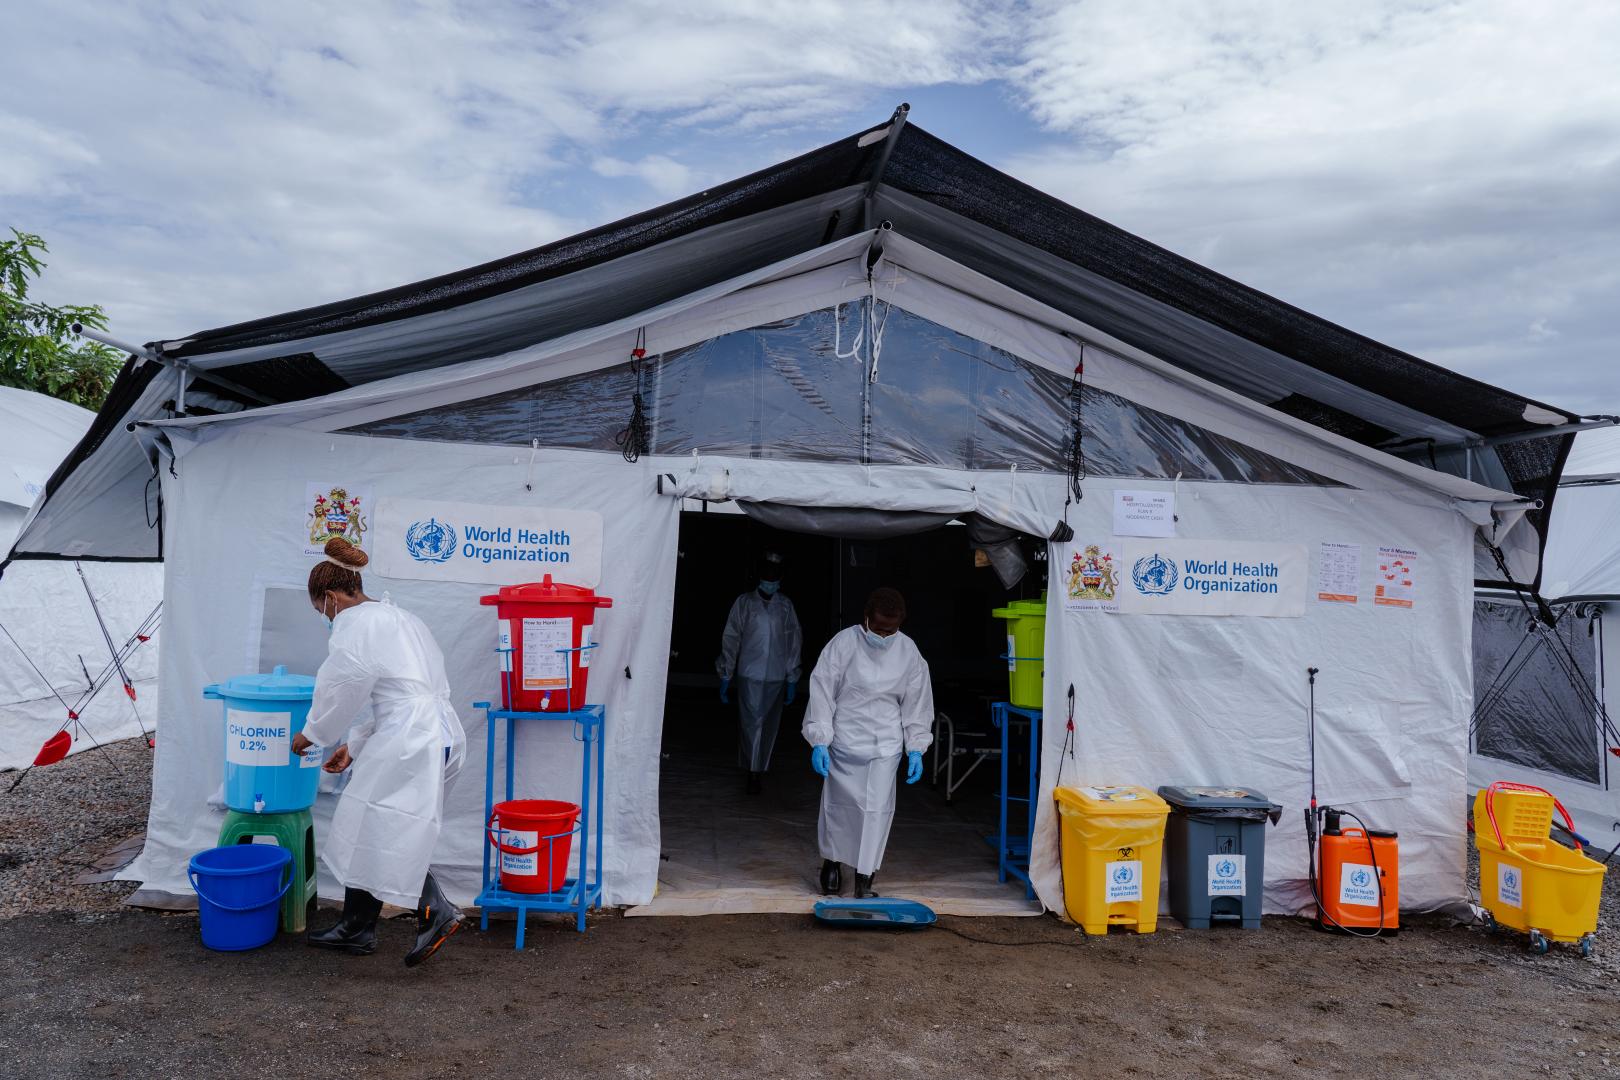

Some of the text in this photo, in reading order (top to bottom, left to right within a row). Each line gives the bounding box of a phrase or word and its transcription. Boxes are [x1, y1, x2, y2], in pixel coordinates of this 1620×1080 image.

[464, 525, 570, 546] World Health
[463, 543, 570, 564] Organization
[1184, 559, 1278, 578] World Health
[1184, 576, 1278, 594] Organization
[230, 724, 286, 738] CHLORINE
[240, 740, 266, 751] 0.2%
